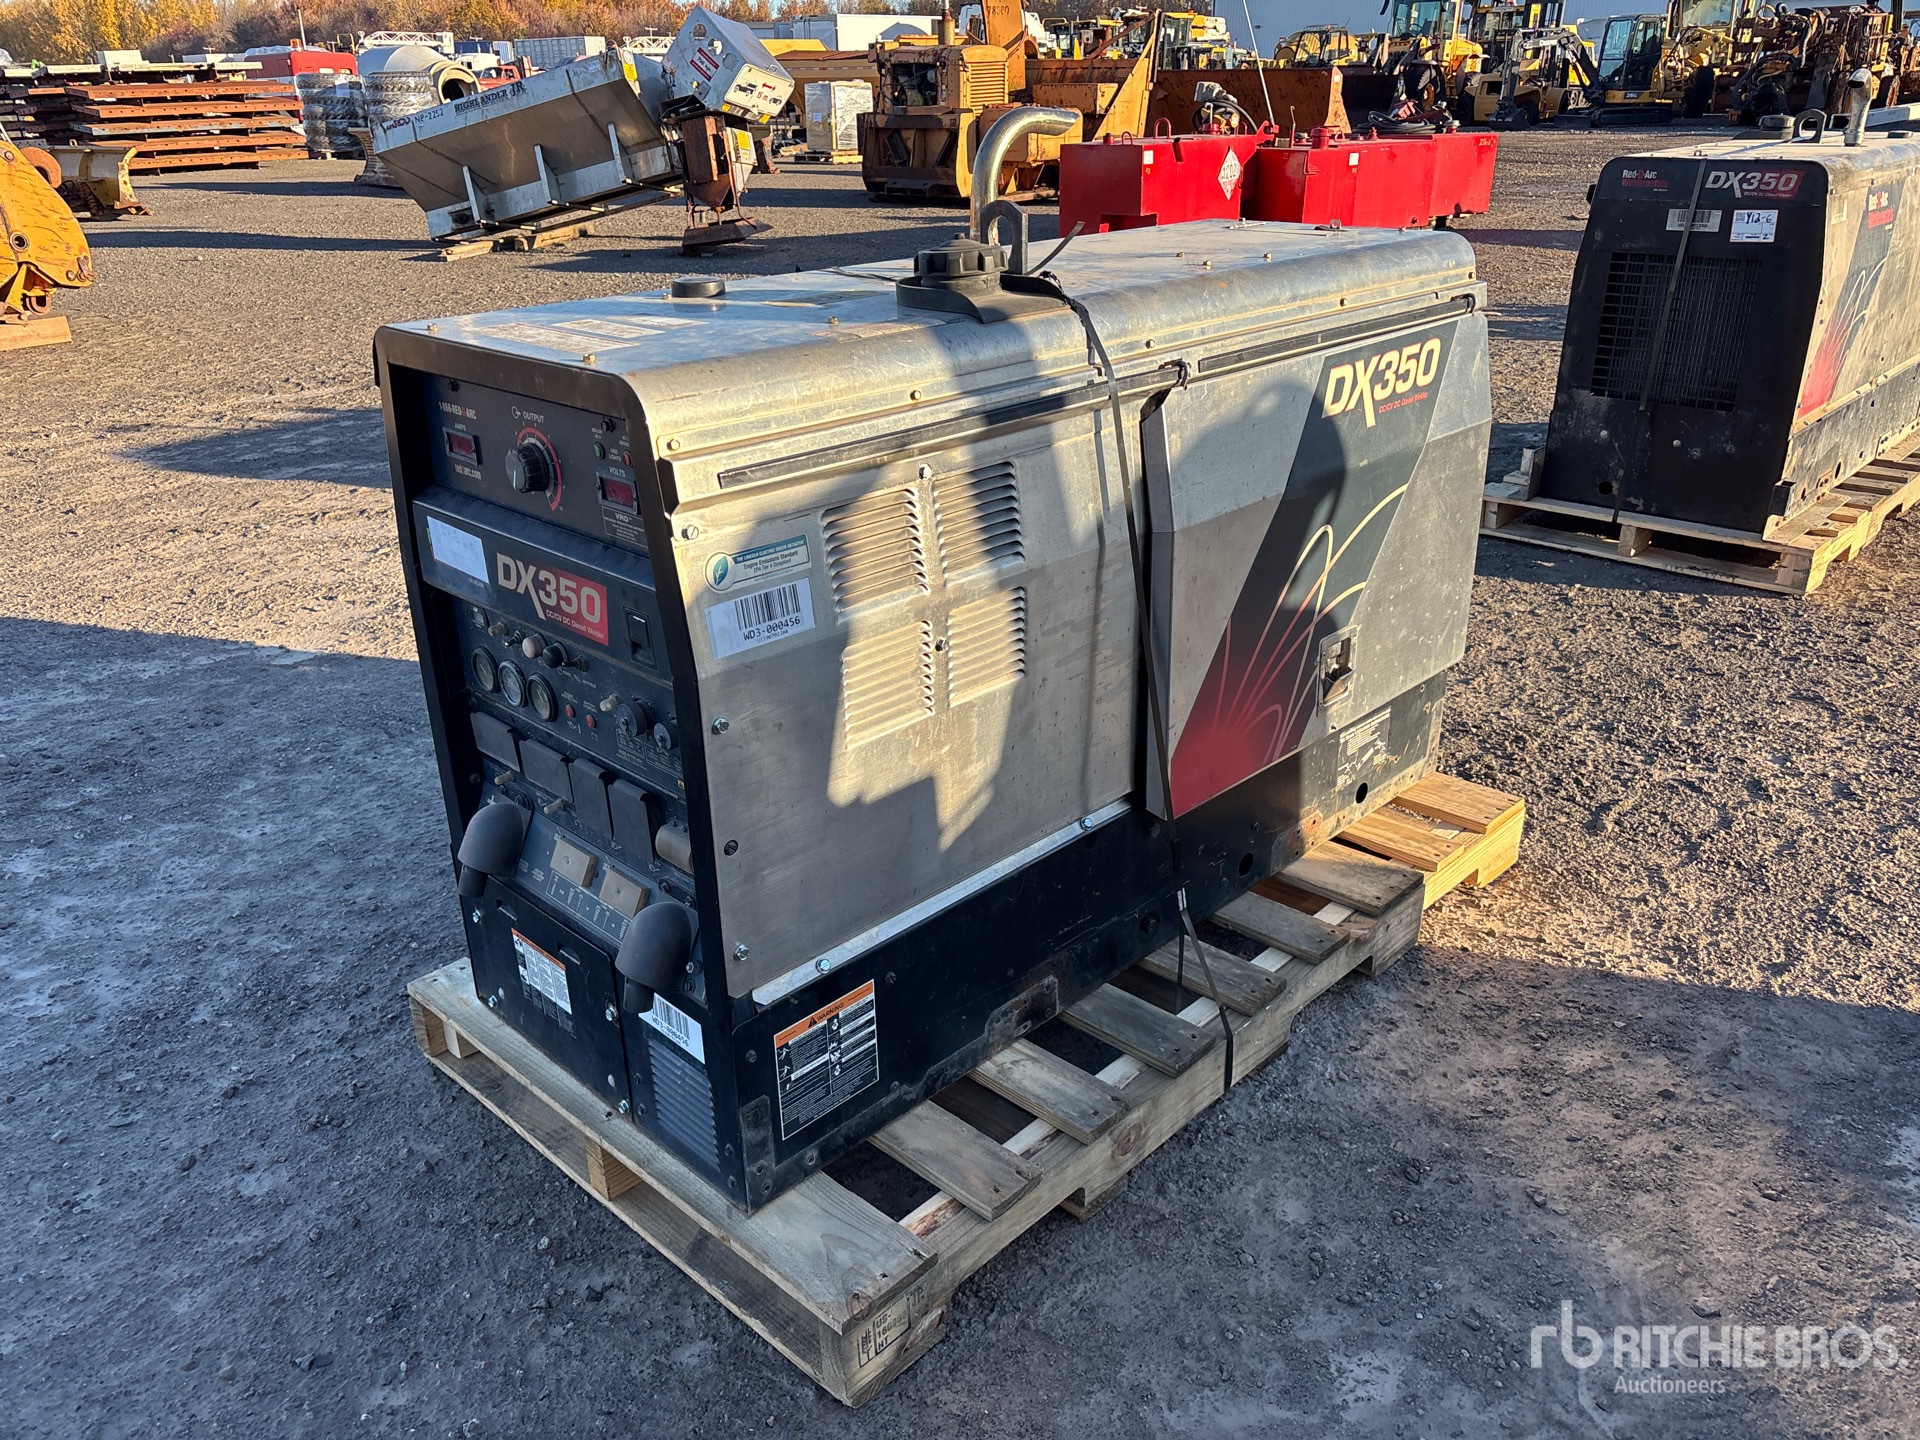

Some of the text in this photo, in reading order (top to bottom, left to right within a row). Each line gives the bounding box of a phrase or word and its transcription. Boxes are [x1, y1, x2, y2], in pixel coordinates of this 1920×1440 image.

[453, 91, 508, 113] HIGHLANDER
[1705, 171, 1798, 198] DX350
[1321, 337, 1442, 429] DX350
[522, 410, 545, 424] OUTPUT
[608, 466, 626, 478] VOLTS
[744, 550, 798, 570] Engine Emissions Standard
[772, 558, 792, 568] Compliant
[496, 552, 601, 624] DX350
[545, 609, 605, 639] CC/CV DC Diesel Welder
[742, 615, 801, 641] WD3-000456
[816, 1002, 845, 1021] WARNING
[878, 1335, 890, 1351] HT
